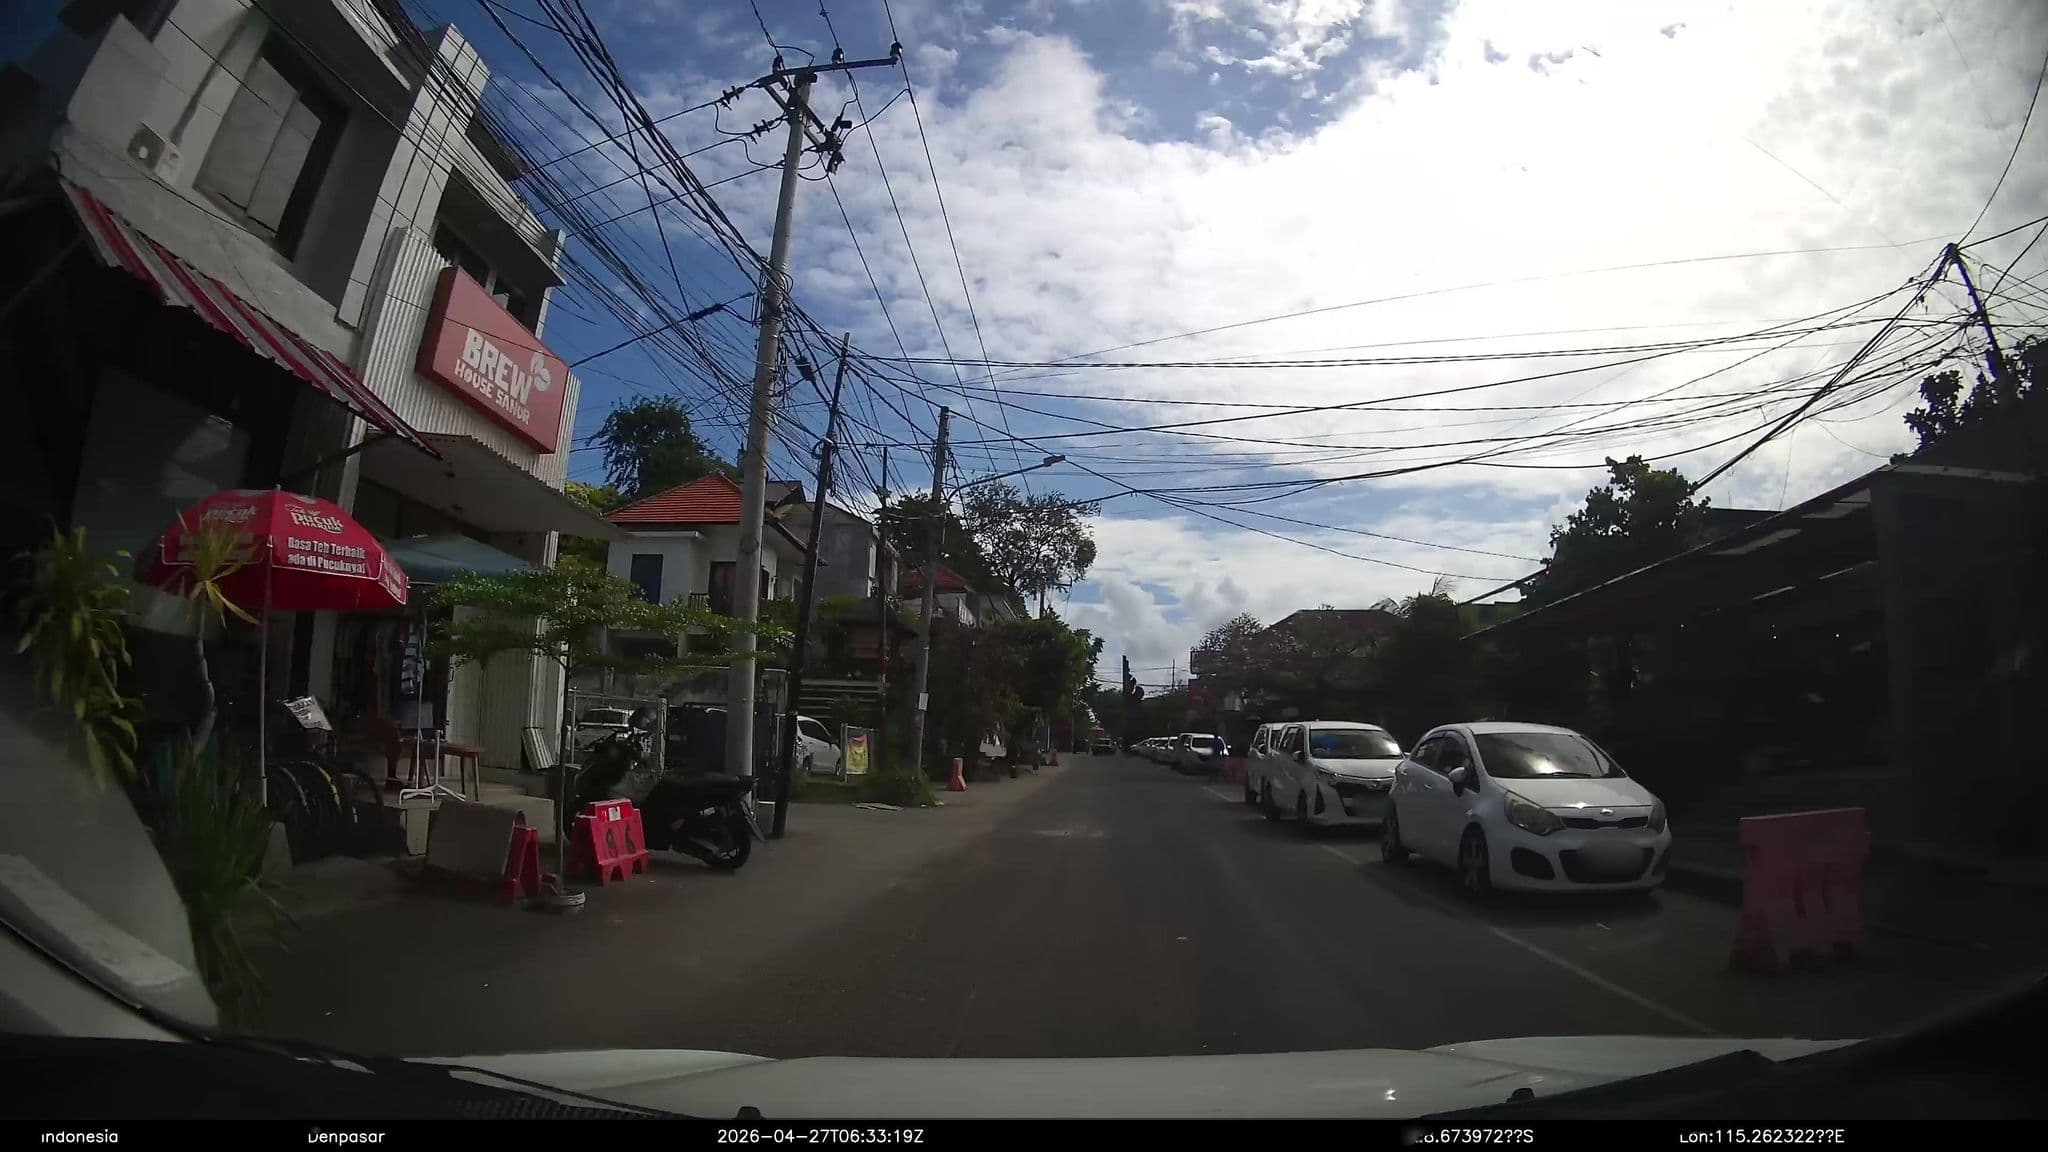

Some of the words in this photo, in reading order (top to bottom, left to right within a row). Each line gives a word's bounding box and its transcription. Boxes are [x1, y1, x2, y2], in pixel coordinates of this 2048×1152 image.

[463, 328, 533, 404] BREW
[454, 359, 494, 399] HOUSE
[496, 389, 530, 425] SANUR
[287, 553, 306, 566] ada
[306, 554, 317, 567] di
[288, 537, 312, 551] Rasa
[312, 540, 330, 554] Teh
[330, 543, 366, 560] Terbaik
